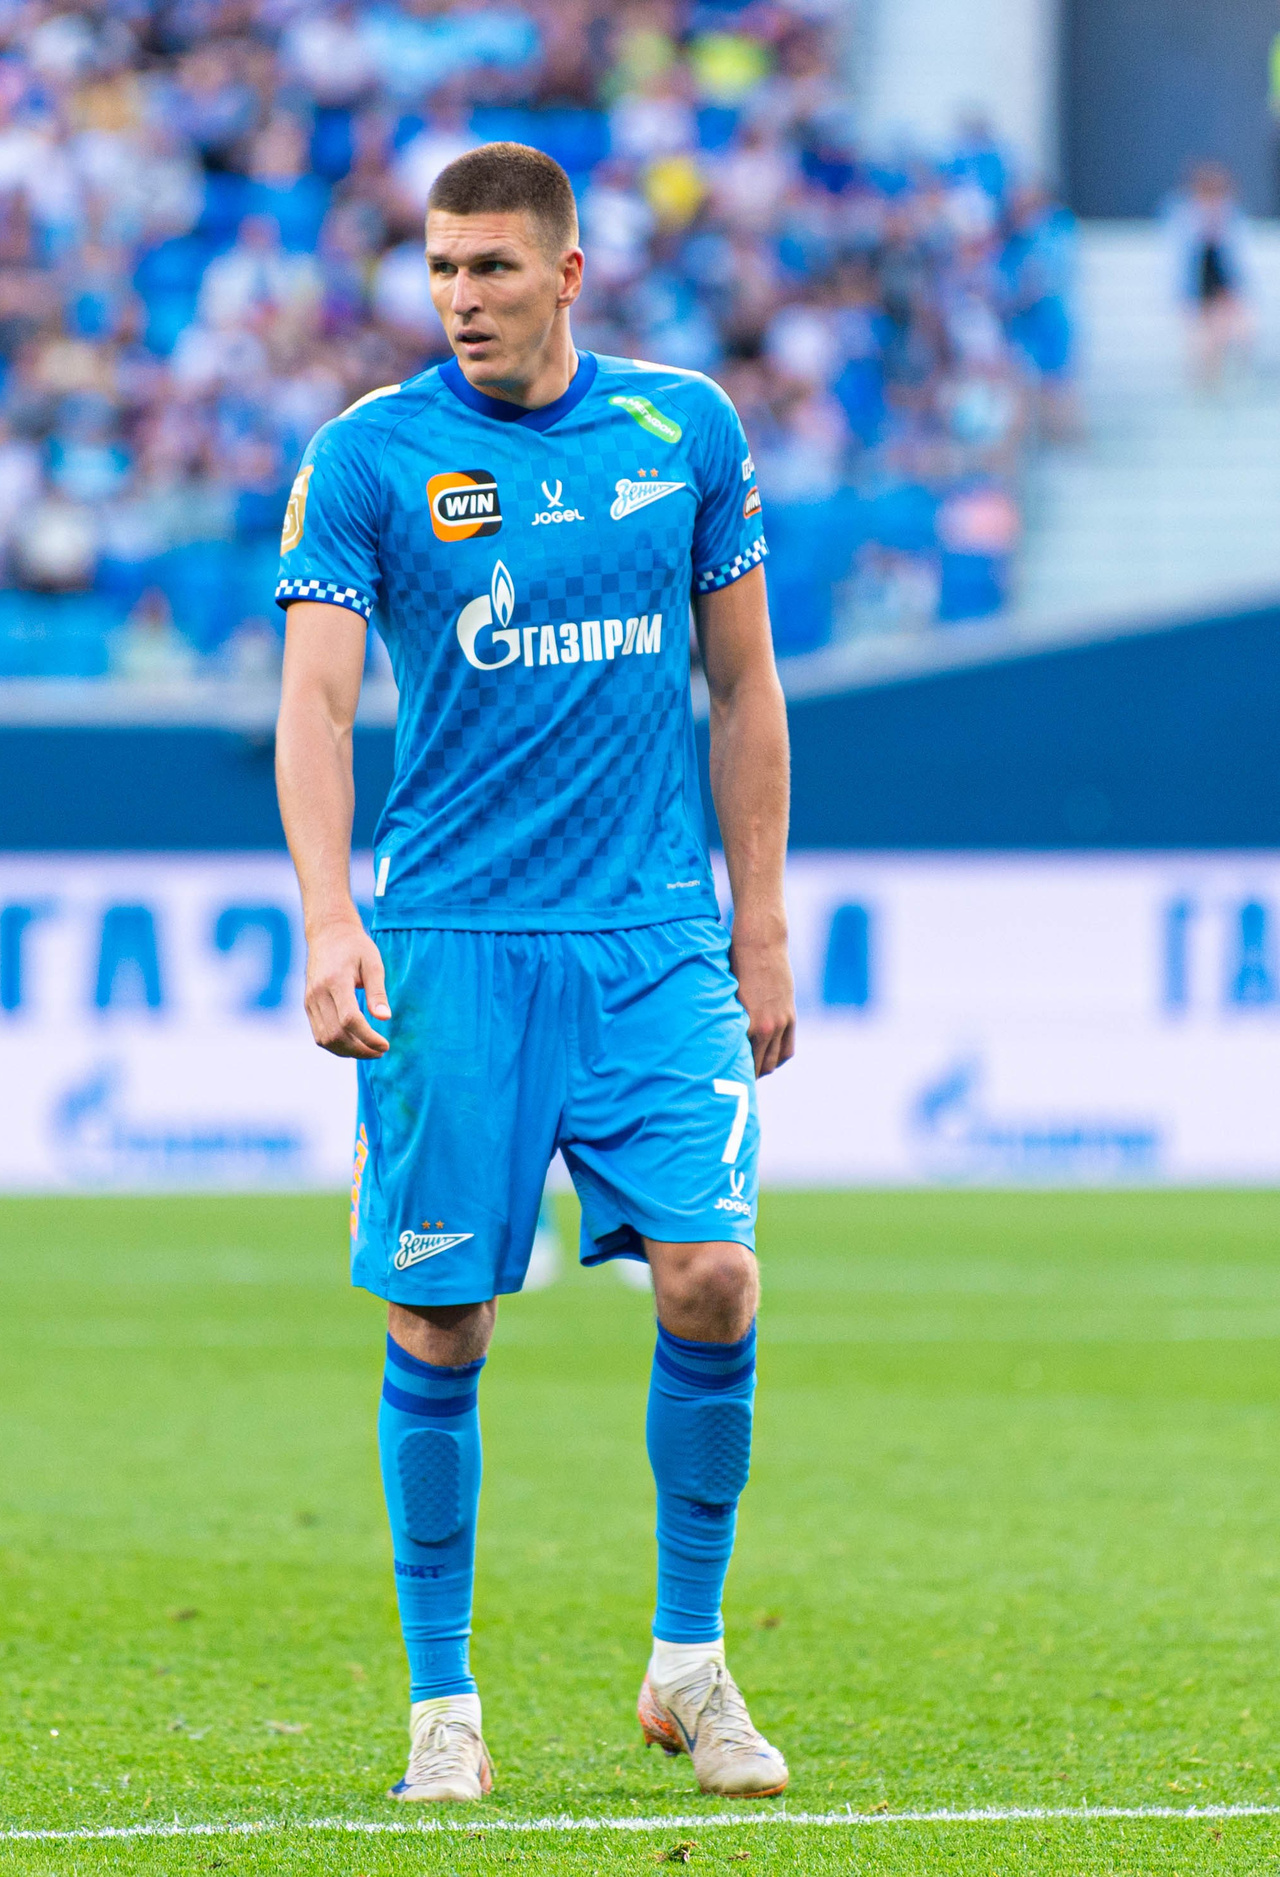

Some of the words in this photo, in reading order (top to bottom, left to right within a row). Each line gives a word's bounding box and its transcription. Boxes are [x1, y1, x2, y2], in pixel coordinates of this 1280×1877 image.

[445, 493, 494, 517] WIN
[522, 613, 663, 667] ГАЗПРОМ
[713, 1078, 749, 1165] 7
